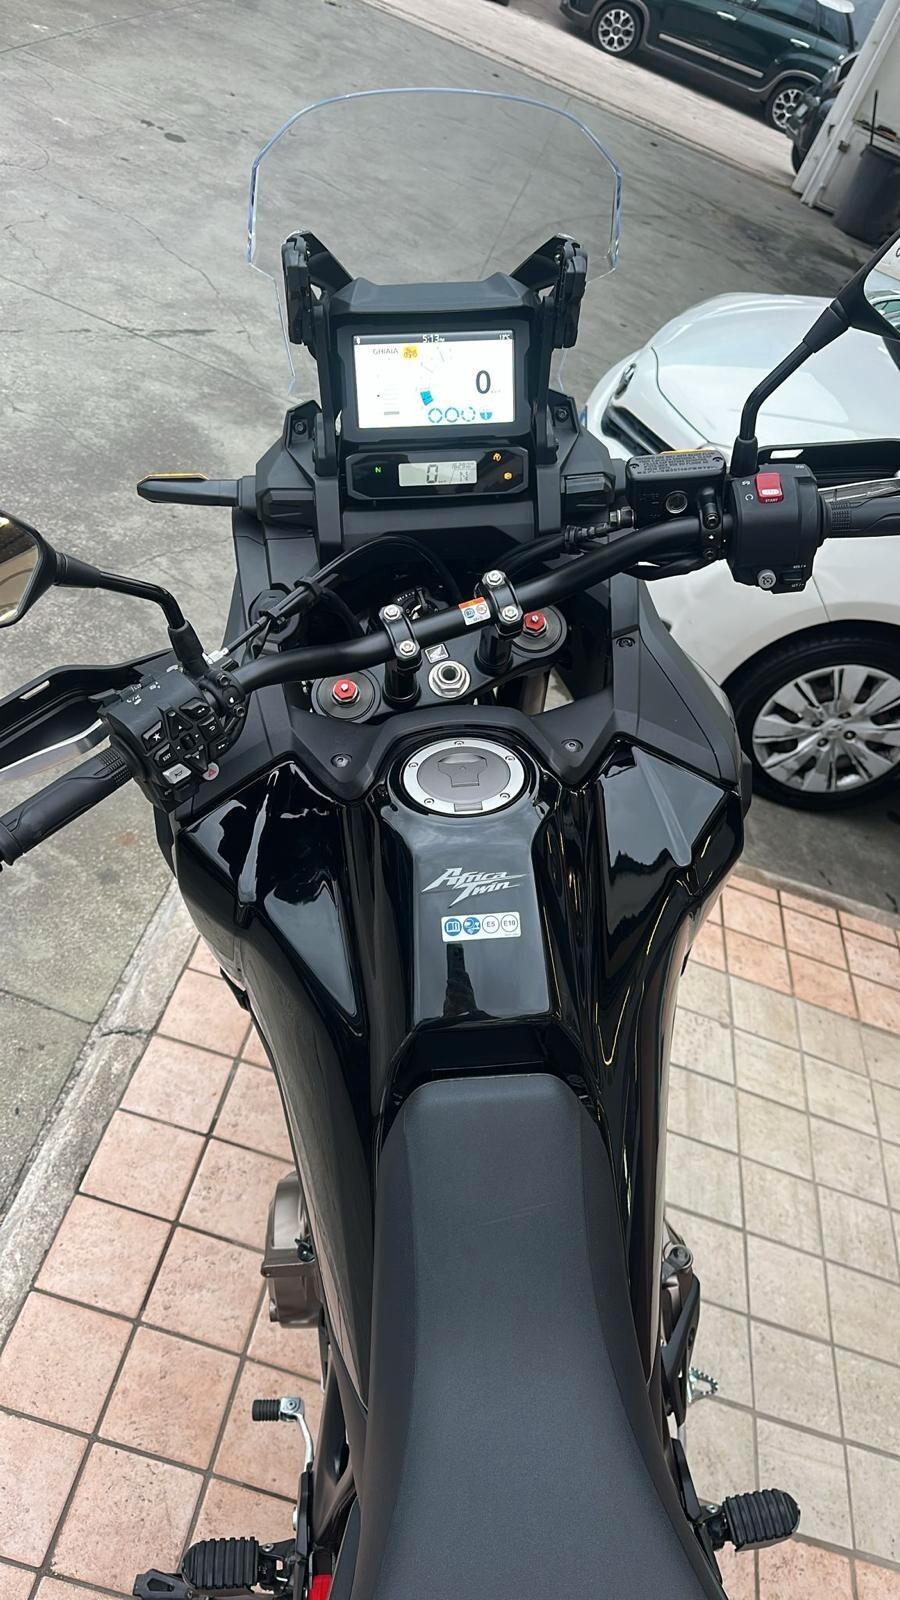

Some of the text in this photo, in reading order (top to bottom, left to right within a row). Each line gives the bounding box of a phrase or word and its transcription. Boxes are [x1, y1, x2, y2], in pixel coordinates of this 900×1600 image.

[476, 369, 491, 394] 0
[426, 463, 439, 484] 0
[420, 867, 527, 894] Africa
[448, 880, 521, 909] Twin
